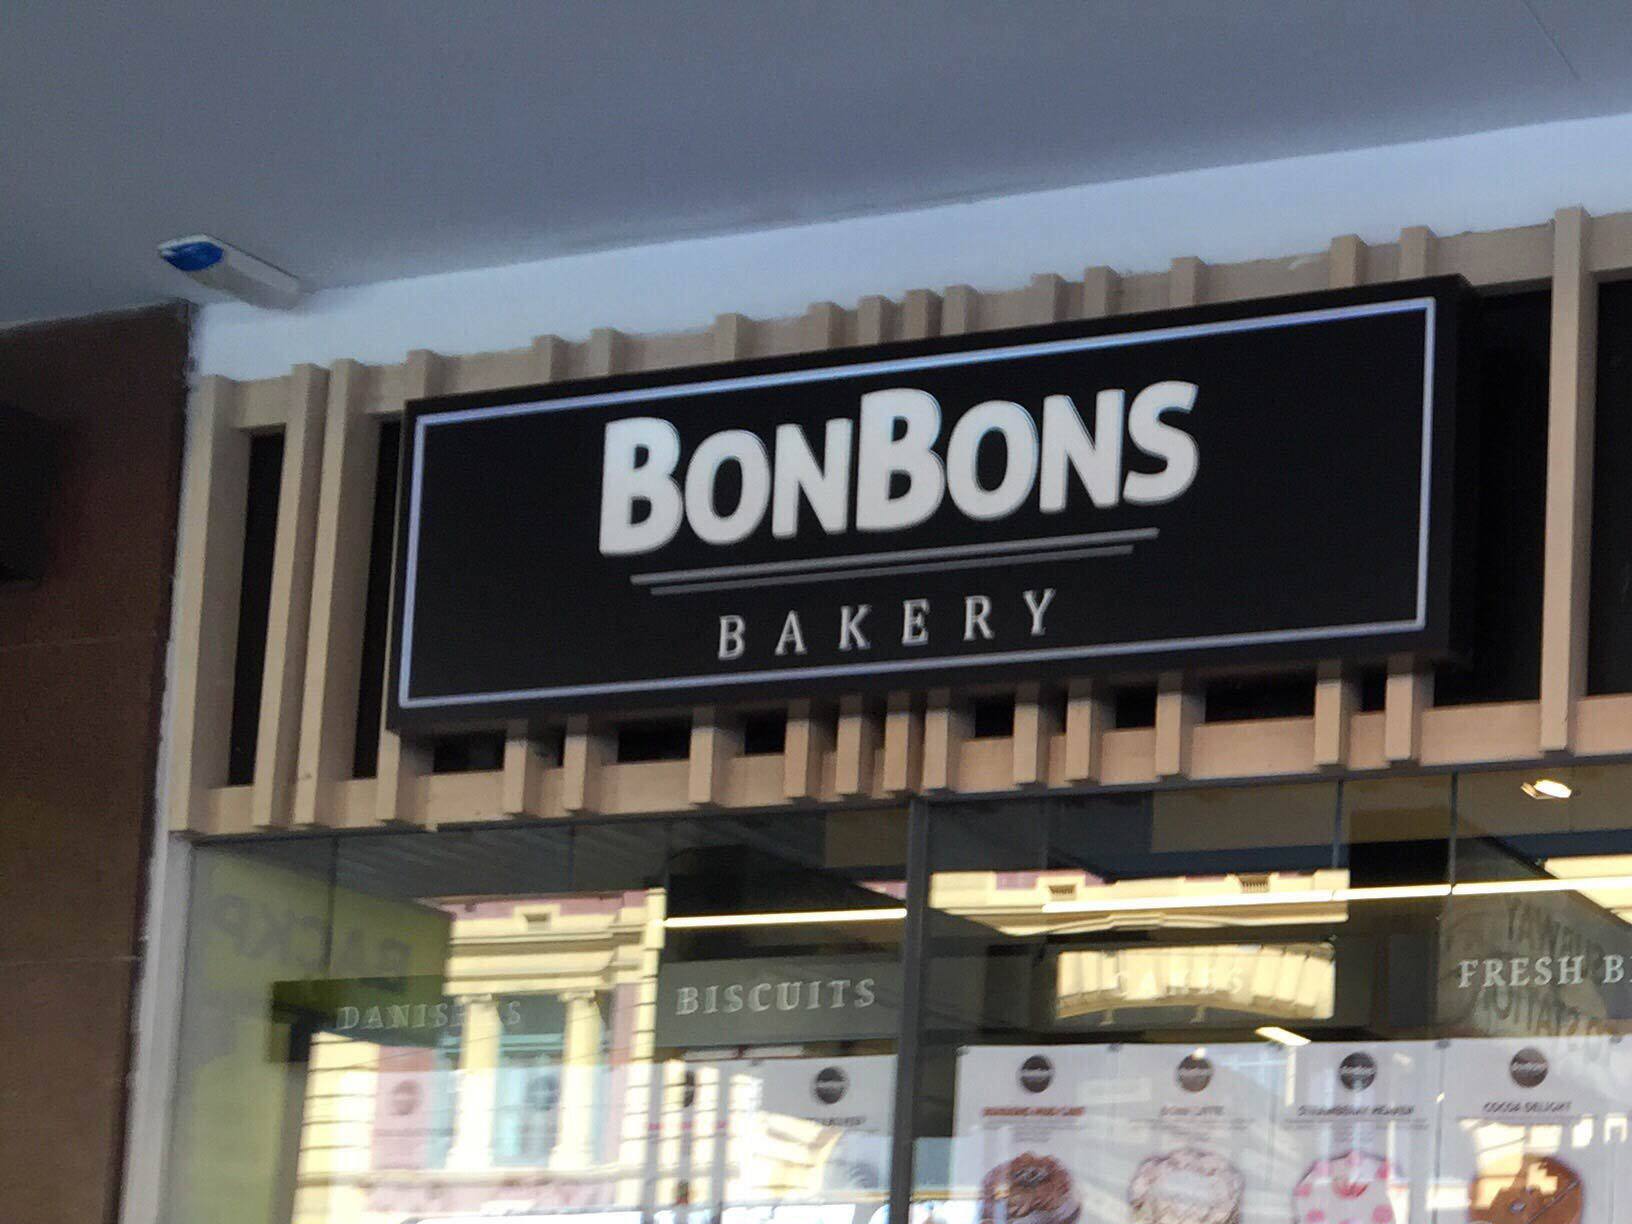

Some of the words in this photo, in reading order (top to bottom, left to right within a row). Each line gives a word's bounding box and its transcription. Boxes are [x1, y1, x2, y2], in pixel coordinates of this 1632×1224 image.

[599, 379, 1199, 556] BONBONS
[717, 588, 1057, 662] BAKERY
[1457, 955, 1585, 988] FRESH
[675, 978, 876, 1015] BISCUITS
[337, 1001, 522, 1030] DANISHS
